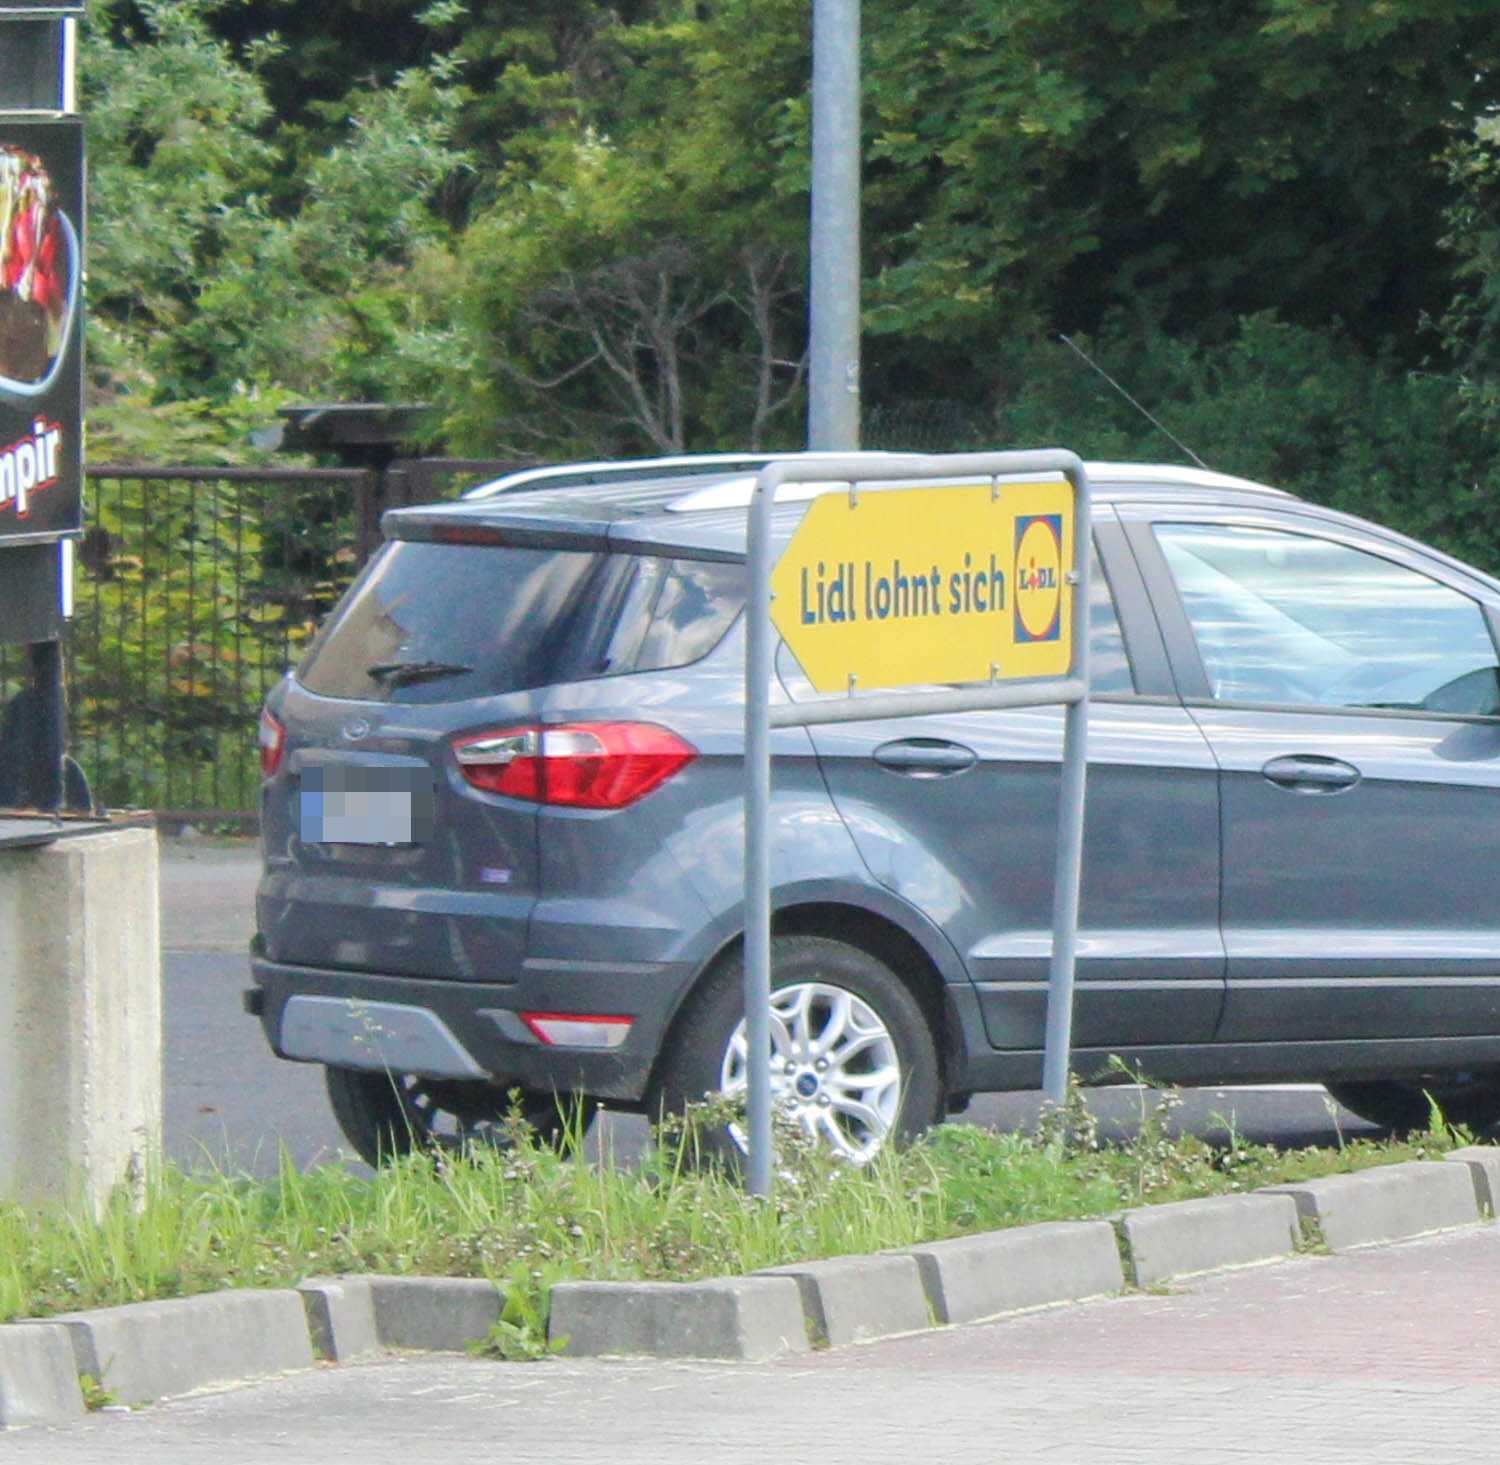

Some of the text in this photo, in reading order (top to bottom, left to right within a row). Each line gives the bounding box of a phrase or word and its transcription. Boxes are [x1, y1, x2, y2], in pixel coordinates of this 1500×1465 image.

[801, 552, 1005, 625] Lidl lohnt sich
